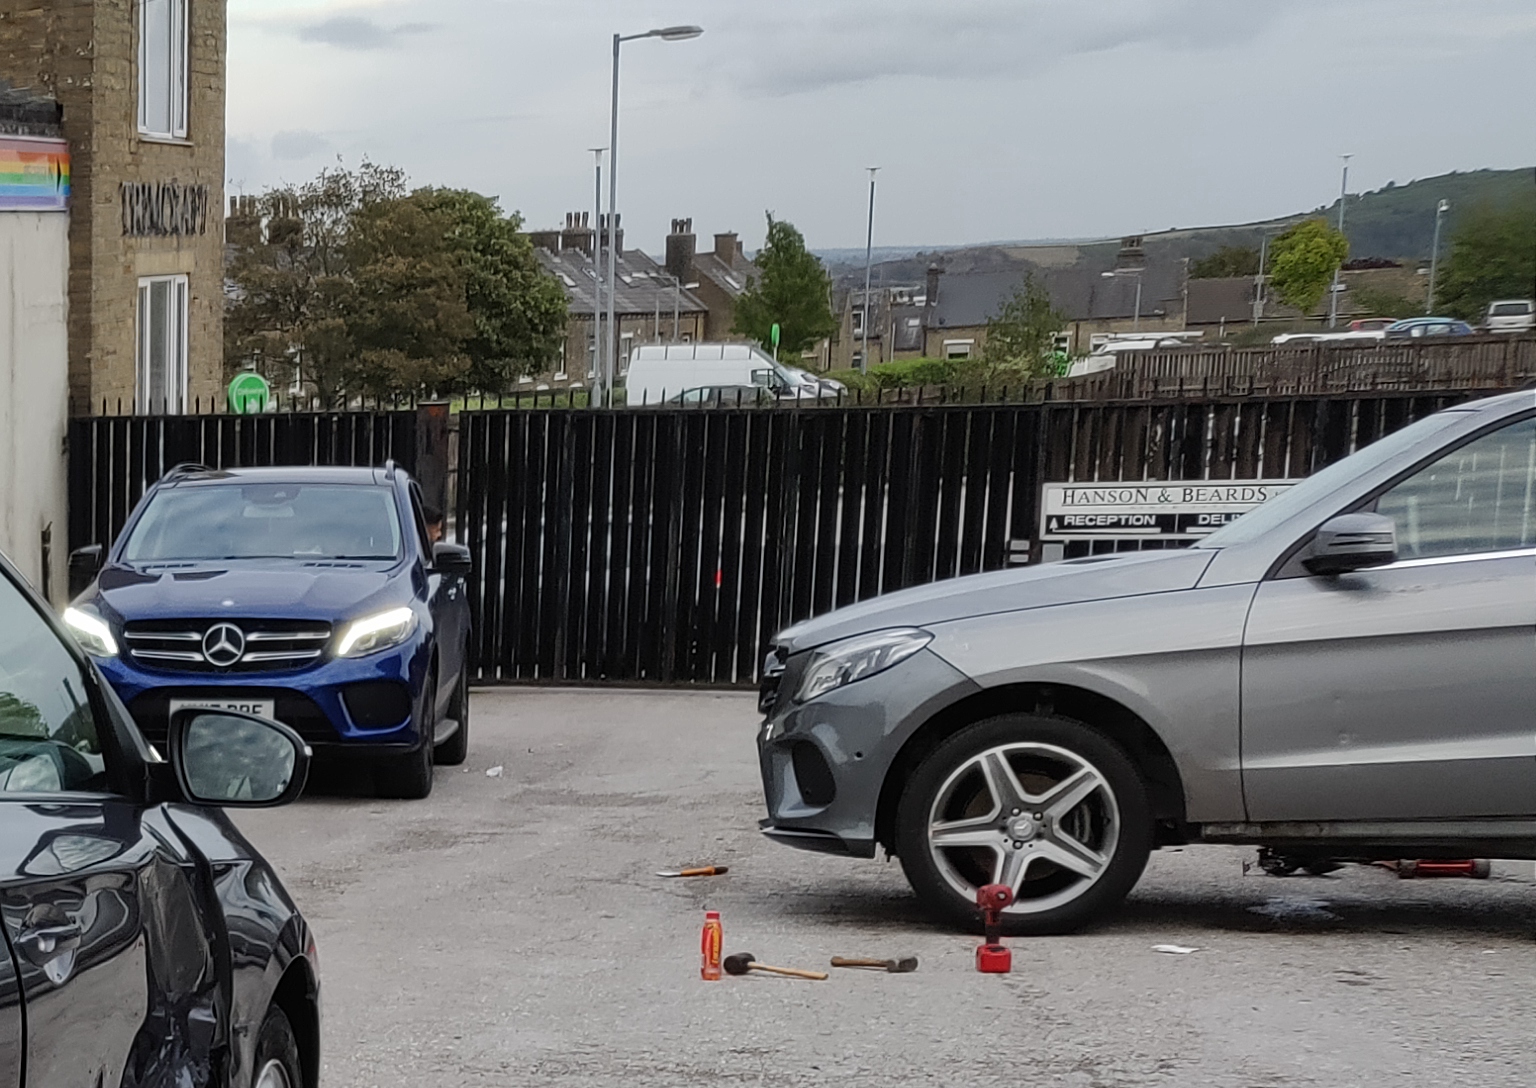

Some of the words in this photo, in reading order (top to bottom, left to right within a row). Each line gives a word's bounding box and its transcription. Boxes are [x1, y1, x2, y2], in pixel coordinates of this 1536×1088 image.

[1061, 487, 1149, 505] HANSON
[1157, 489, 1172, 503] &
[1182, 487, 1268, 503] BEARDS
[1064, 515, 1157, 526] RECEPTION
